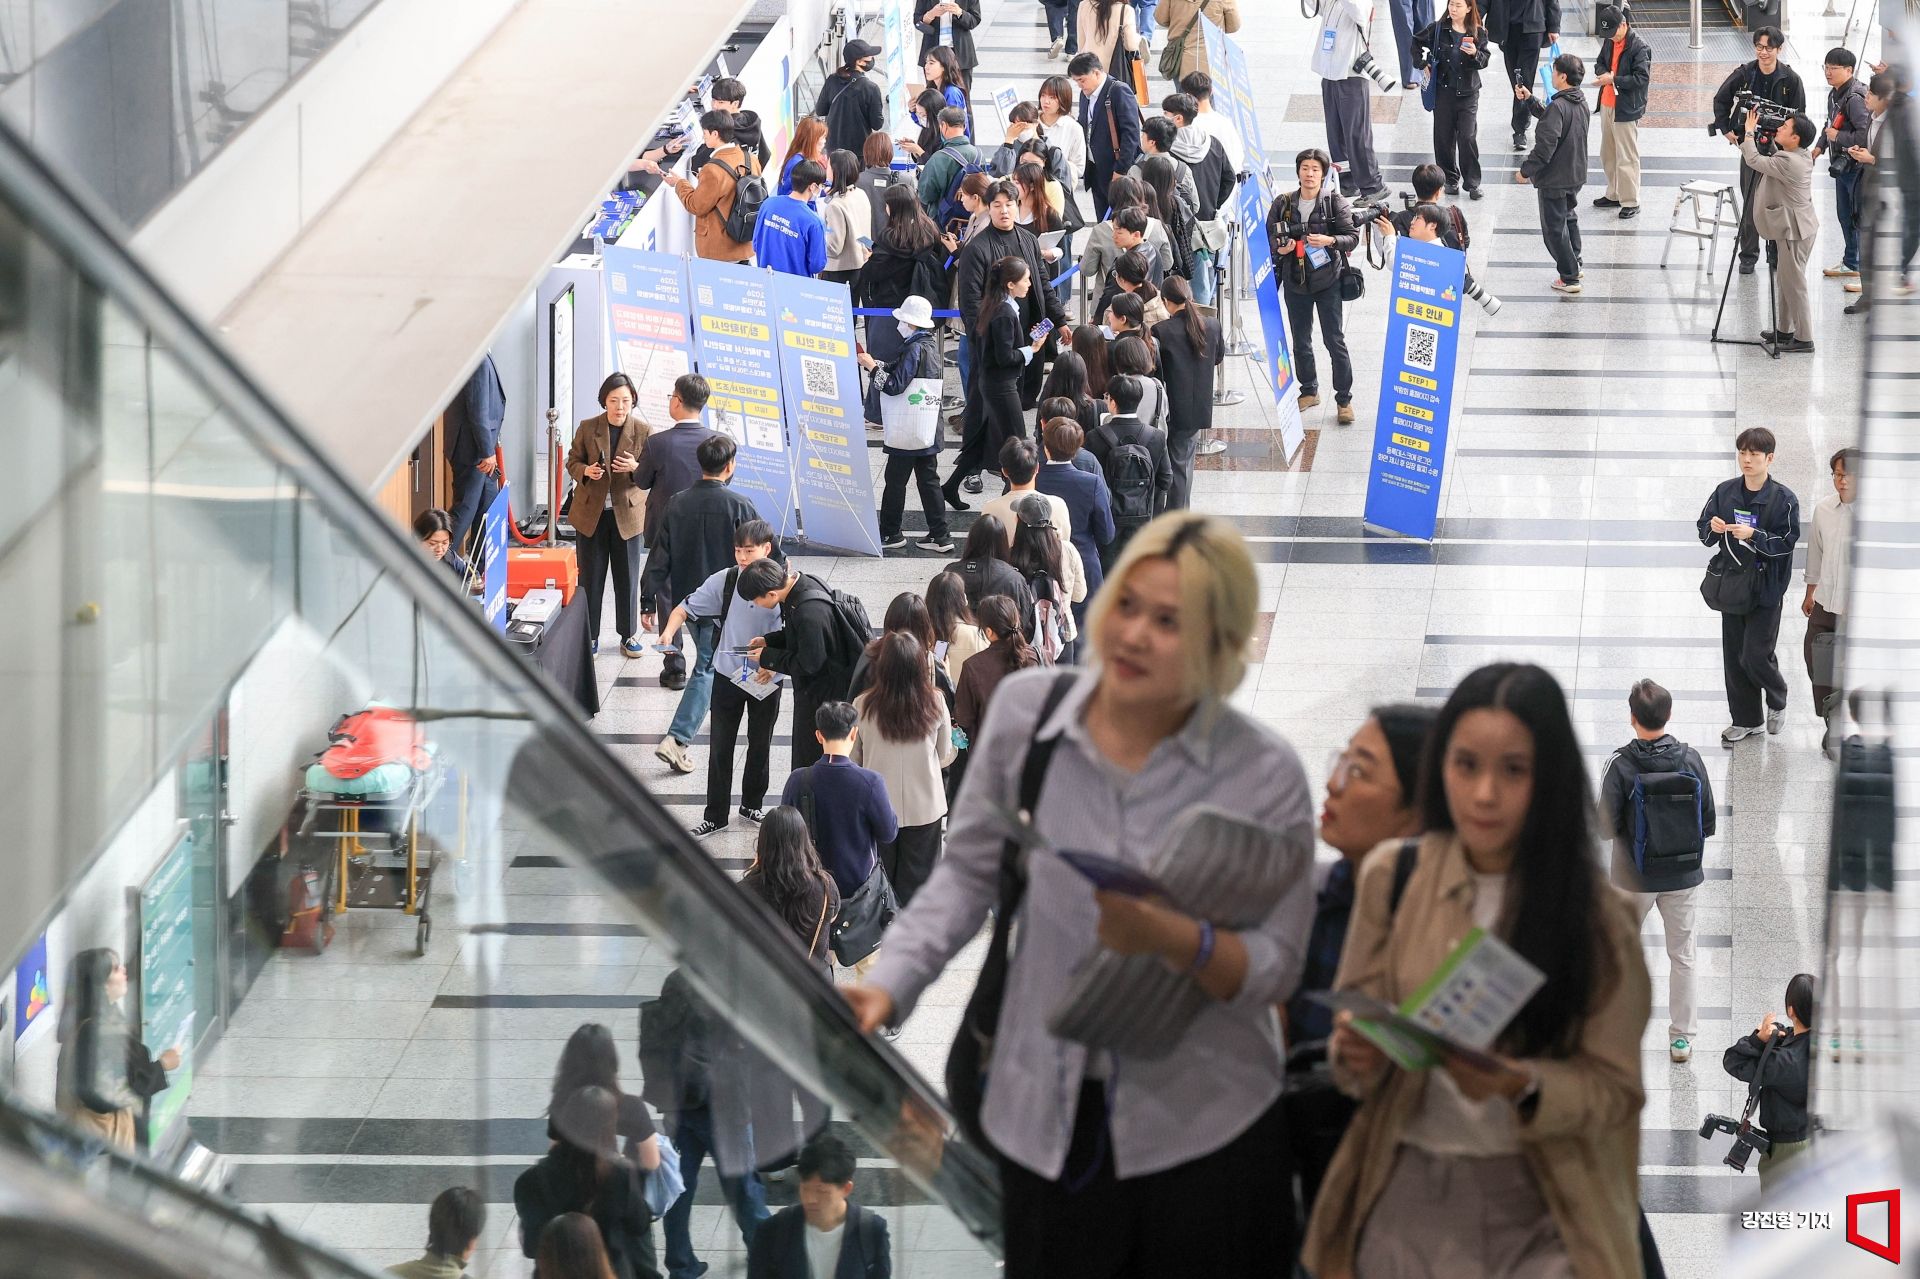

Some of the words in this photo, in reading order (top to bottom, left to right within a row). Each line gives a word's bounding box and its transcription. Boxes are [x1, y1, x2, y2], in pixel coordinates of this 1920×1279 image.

[1401, 262, 1416, 271] 2026
[1400, 271, 1420, 282] 대한민국
[1399, 280, 1409, 289] 상생
[1410, 283, 1436, 296] 채용박람회
[1407, 303, 1423, 316] 등록
[1426, 308, 1443, 322] 안내
[1408, 376, 1423, 385] STEP
[1393, 384, 1409, 396] 박람회
[1410, 390, 1429, 401] 홈페이지
[1429, 394, 1440, 404] 접속
[1404, 406, 1419, 415] STEP
[1393, 416, 1413, 428] 홈페이지
[1414, 422, 1434, 434] 회원가입
[1400, 436, 1416, 446] STEP
[1378, 453, 1388, 462] 화면
[1389, 456, 1399, 464] 제시
[1406, 461, 1416, 470] 입장
[1387, 446, 1417, 460] 등록데스크에
[1417, 455, 1432, 466] 로그인
